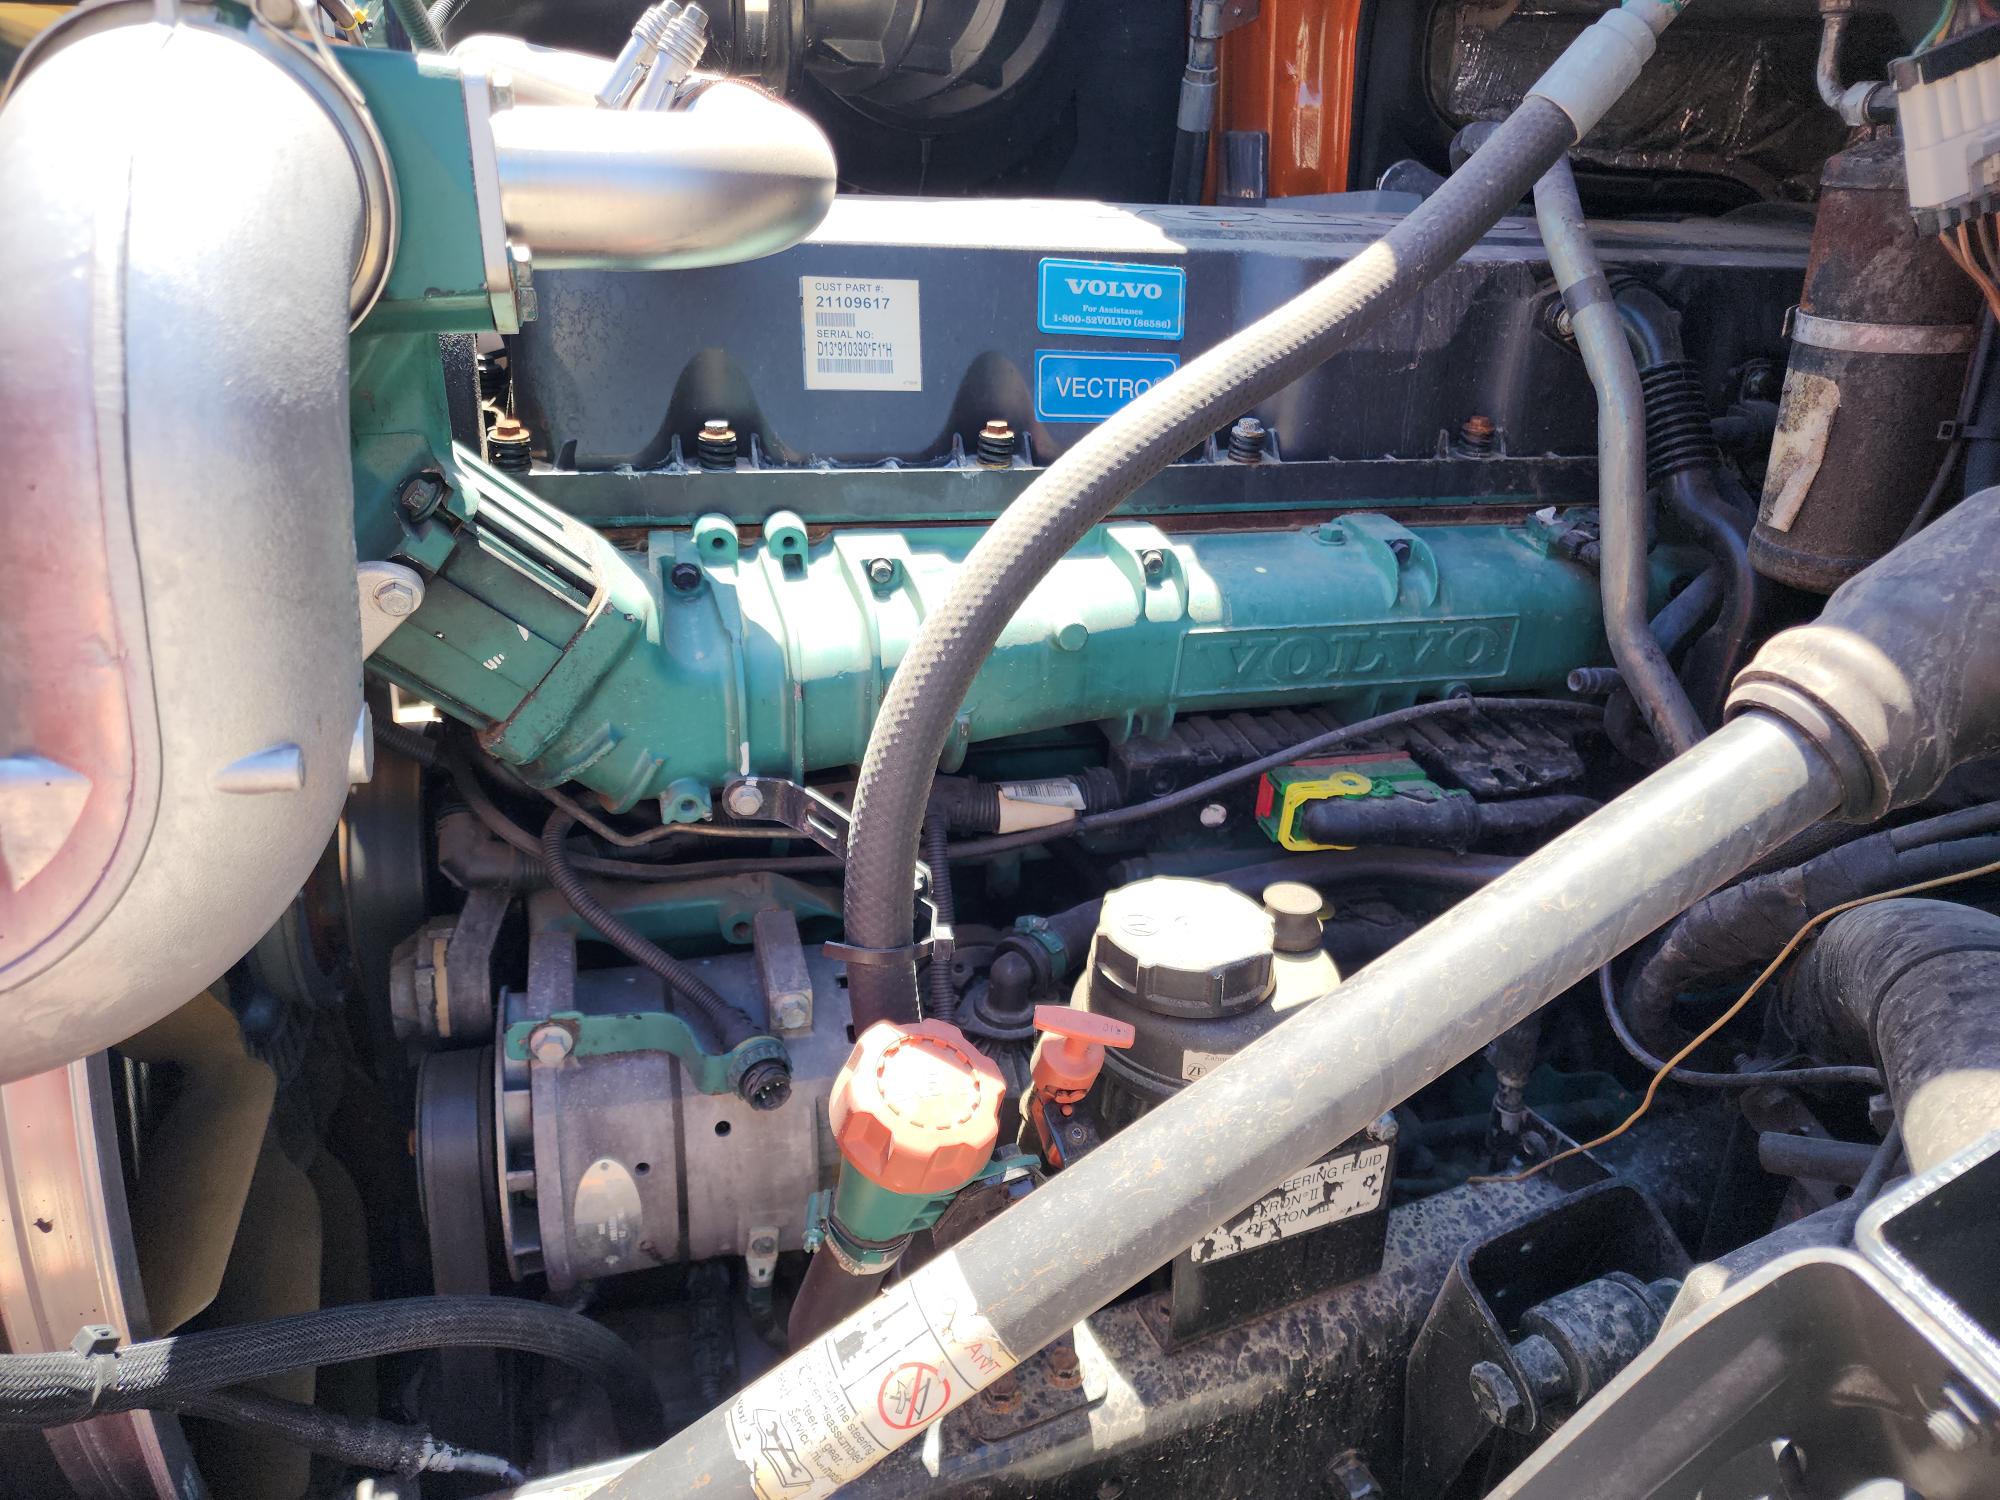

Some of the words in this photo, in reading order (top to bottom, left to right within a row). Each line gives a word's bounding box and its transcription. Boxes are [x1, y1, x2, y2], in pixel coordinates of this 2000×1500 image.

[815, 282, 842, 291] CUST
[846, 284, 872, 293] PART
[875, 285, 884, 293] #:
[1065, 278, 1162, 299] VOLVO
[816, 296, 890, 309] 21109617
[1082, 304, 1097, 313] For
[1099, 305, 1143, 316] Assistance
[1053, 314, 1132, 327] 1-800-52VOLVO
[816, 330, 852, 339] SERIAL
[856, 331, 874, 339] NO:
[1198, 626, 1501, 682] VOLVO
[1283, 1167, 1337, 1192] EERING
[1342, 1154, 1382, 1175] FLUID
[823, 1404, 864, 1465] isassembled
[836, 1404, 850, 1423] the
[847, 1423, 876, 1457] steering
[823, 1443, 843, 1466] gear.
